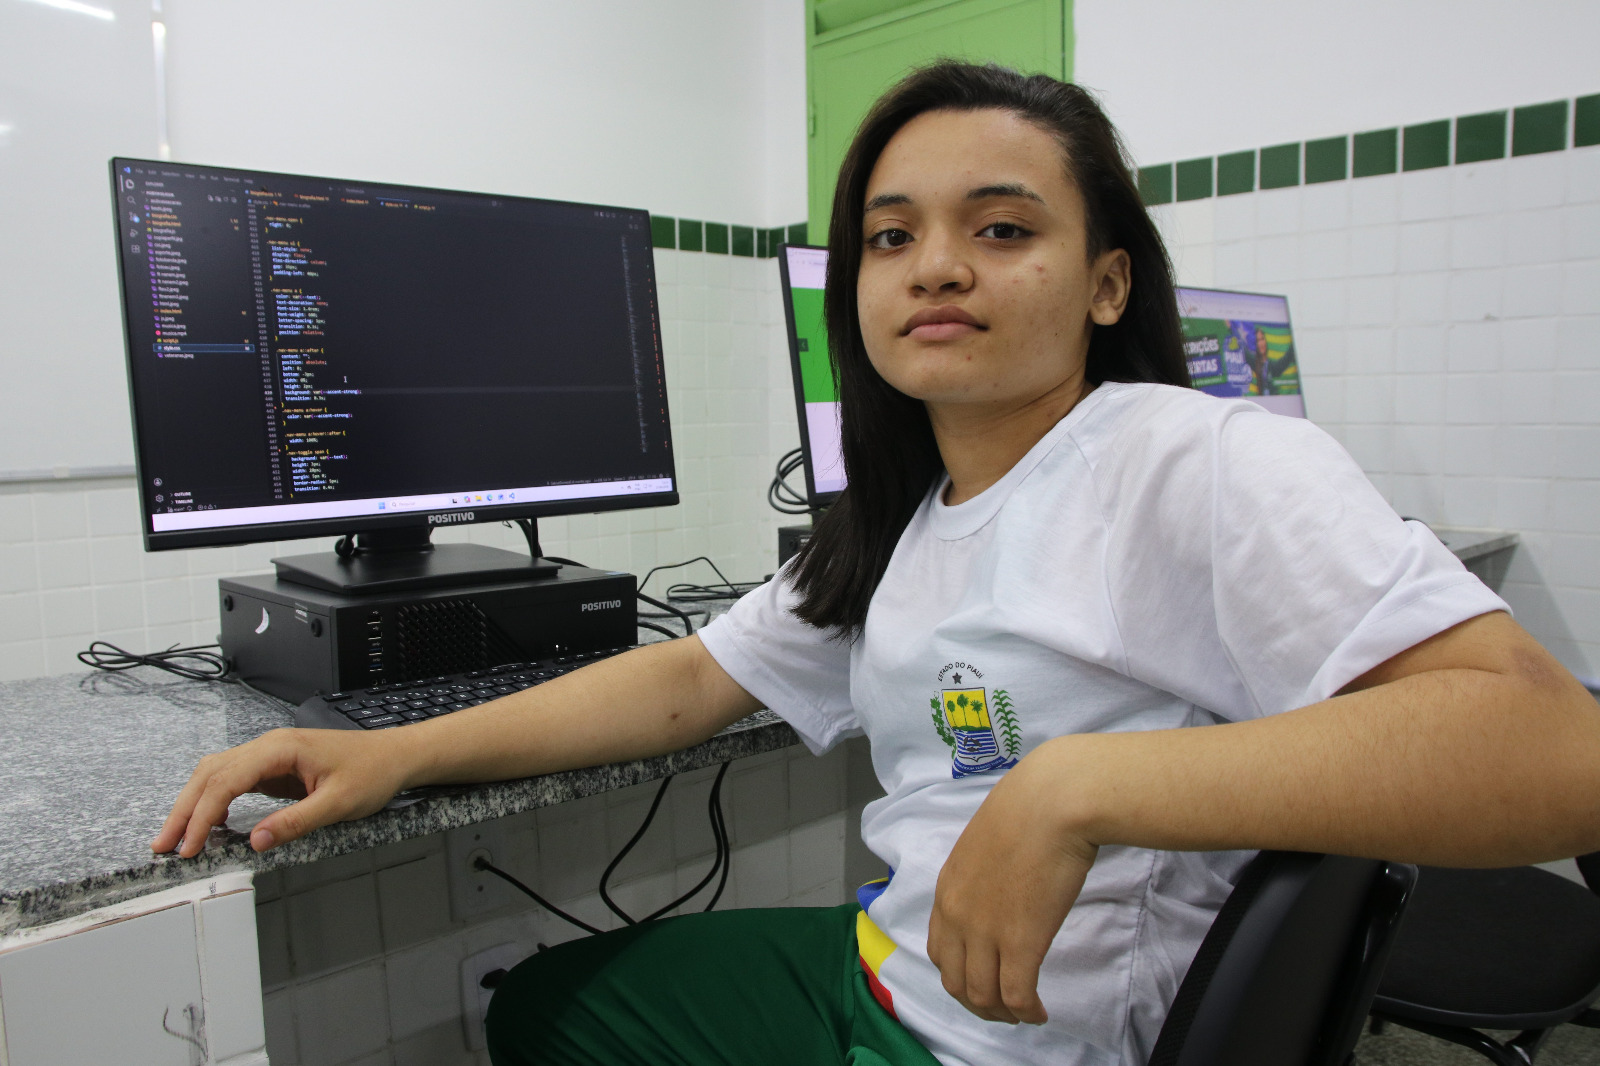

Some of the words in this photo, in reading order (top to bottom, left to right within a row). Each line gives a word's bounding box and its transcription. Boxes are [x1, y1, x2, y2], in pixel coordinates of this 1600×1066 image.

[428, 511, 475, 524] POSITIVO
[581, 600, 622, 612] POSITIVO
[938, 663, 954, 682] ESTADO
[966, 664, 985, 679] PIAUÍ
